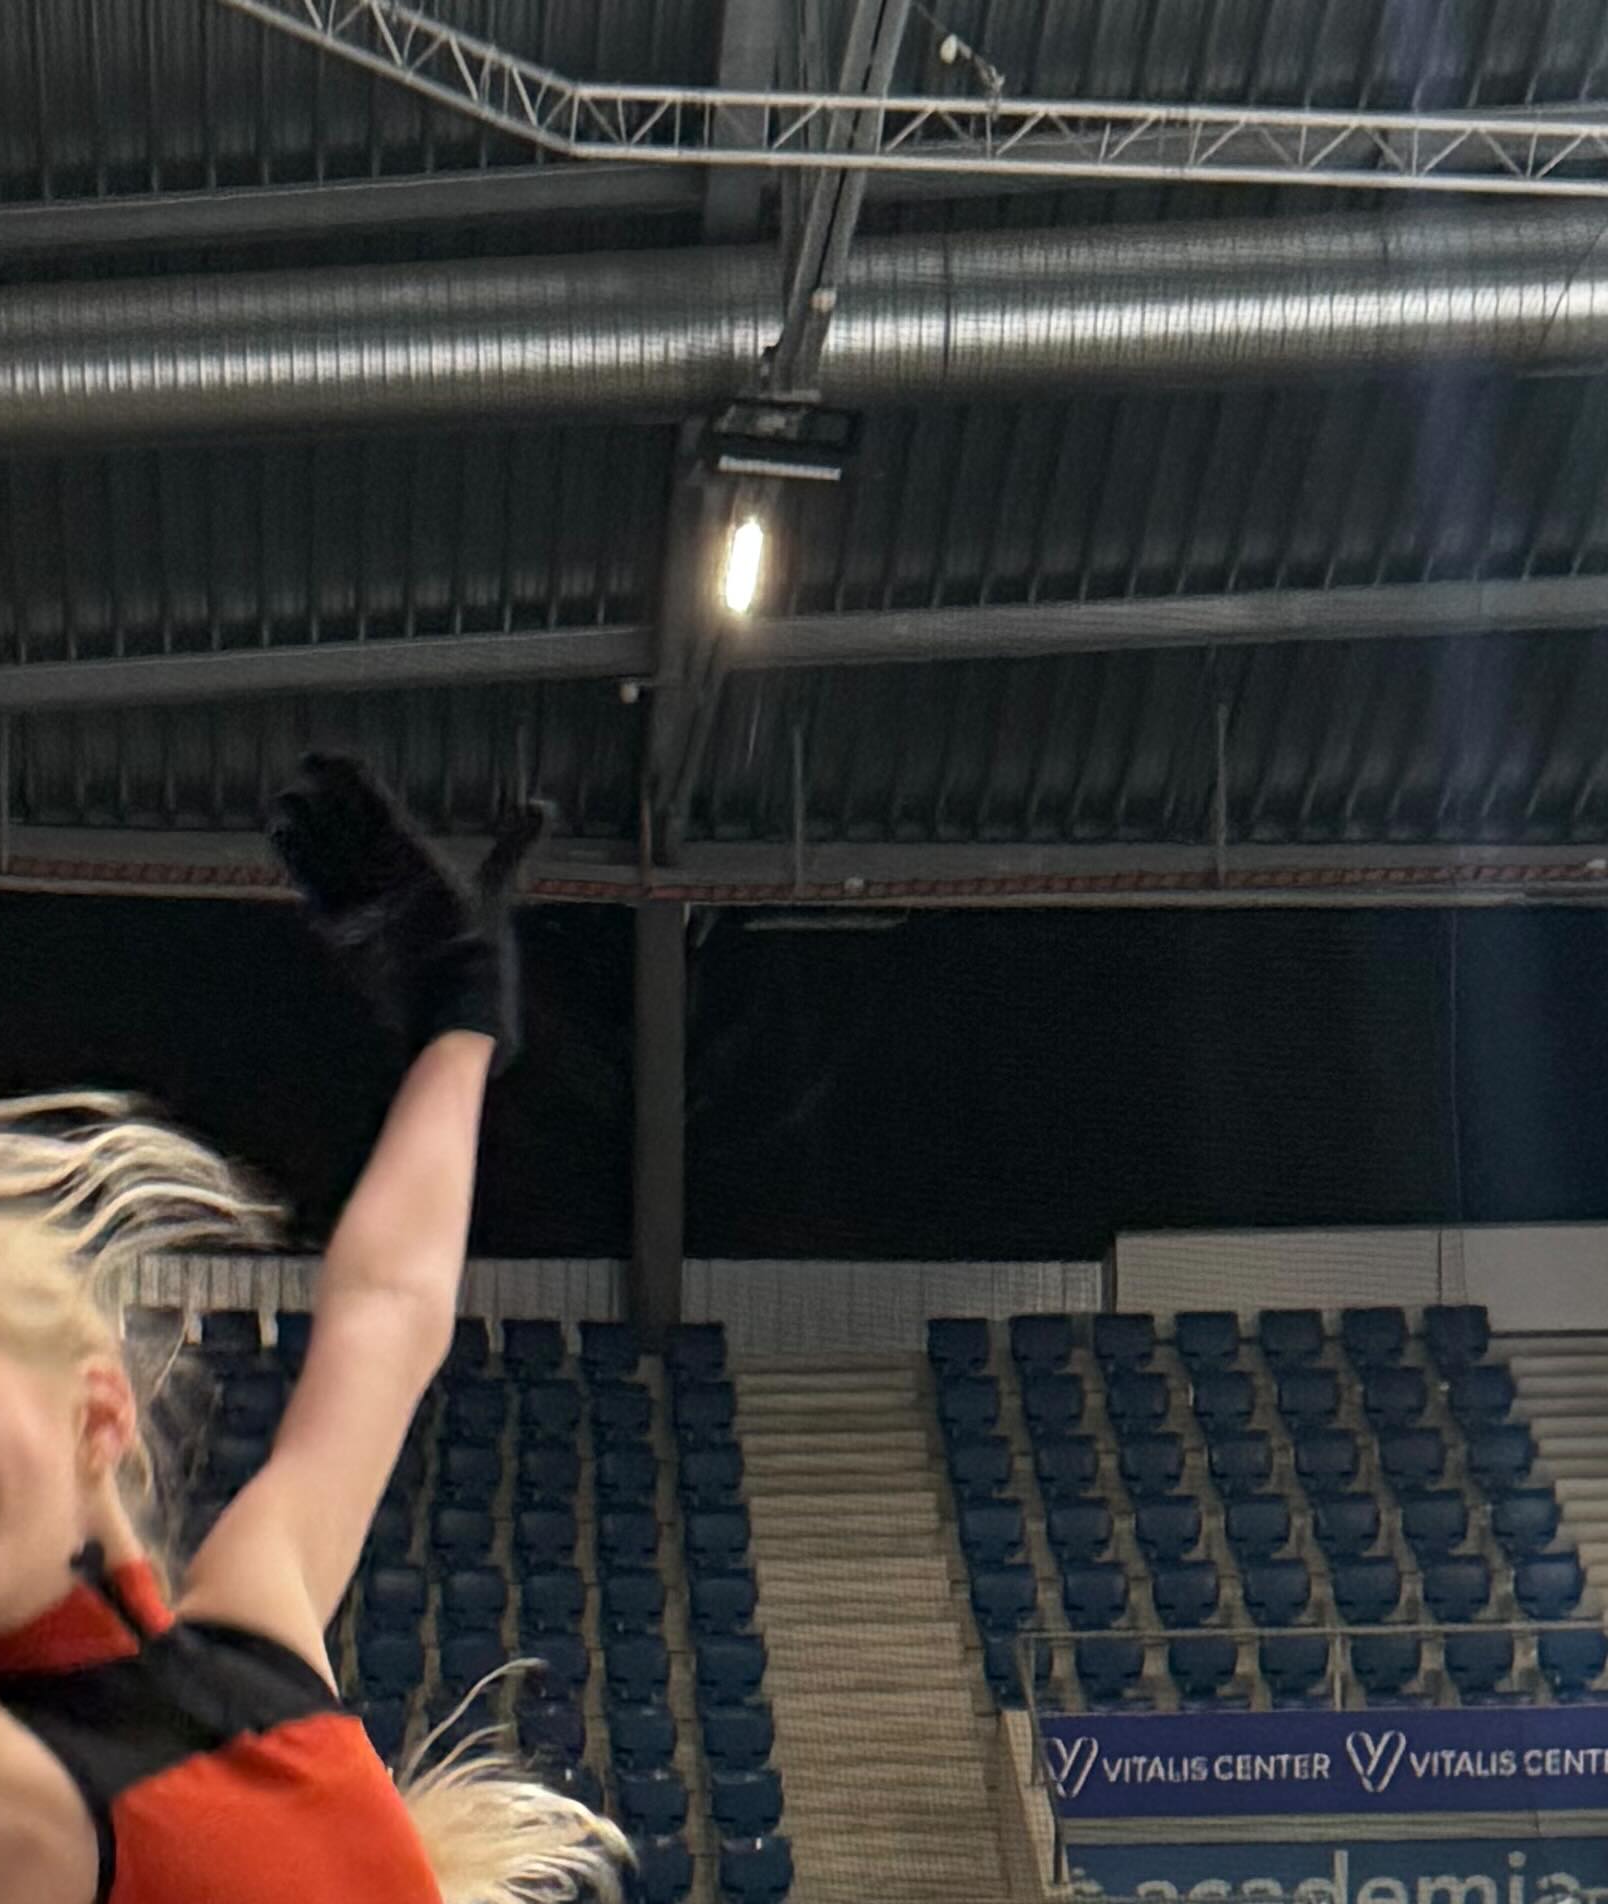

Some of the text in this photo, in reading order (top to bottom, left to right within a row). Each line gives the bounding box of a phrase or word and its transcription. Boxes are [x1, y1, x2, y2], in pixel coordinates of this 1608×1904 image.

[1102, 1753, 1331, 1784] VITALIS CENTER
[1409, 1748, 1608, 1778] VITALIS CENT
